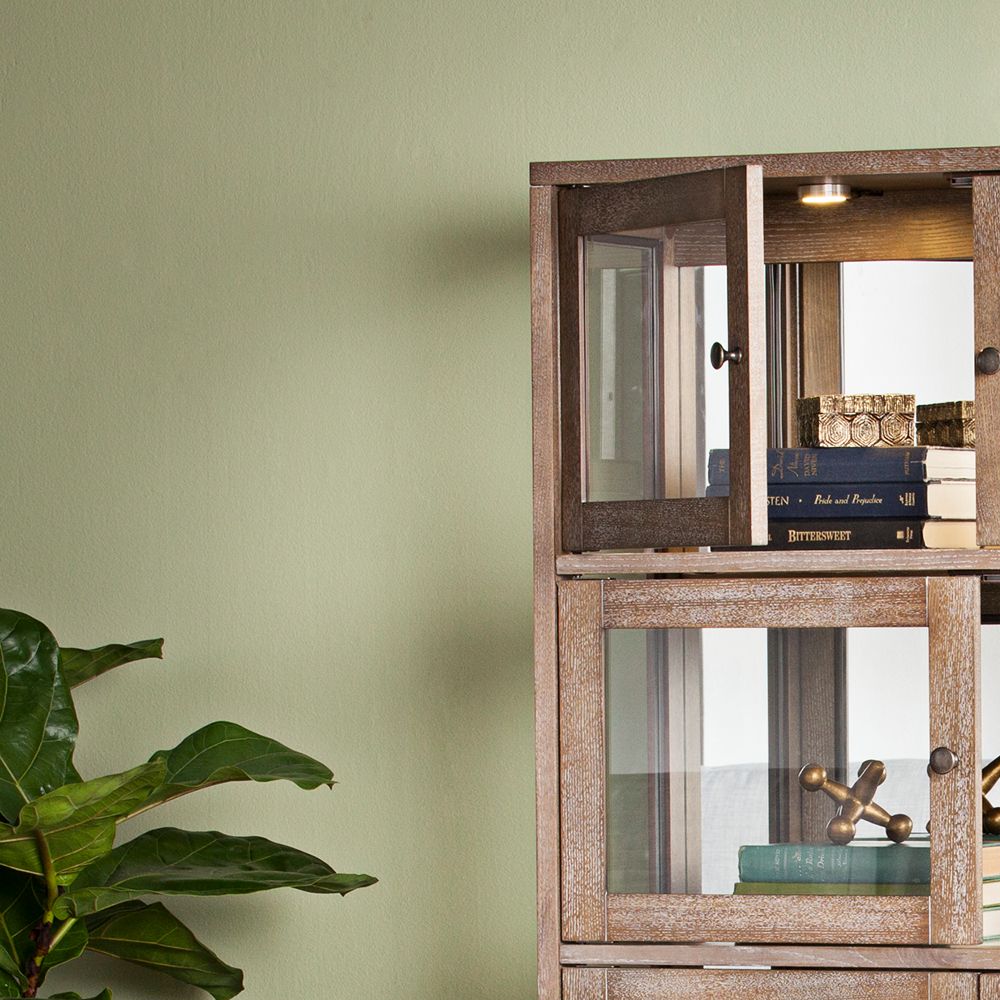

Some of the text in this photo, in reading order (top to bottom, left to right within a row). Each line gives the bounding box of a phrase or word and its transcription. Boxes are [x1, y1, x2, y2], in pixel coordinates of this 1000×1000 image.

[767, 493, 883, 506] STEN Pride and Prejudice
[788, 529, 852, 543] BITTERSWEET
